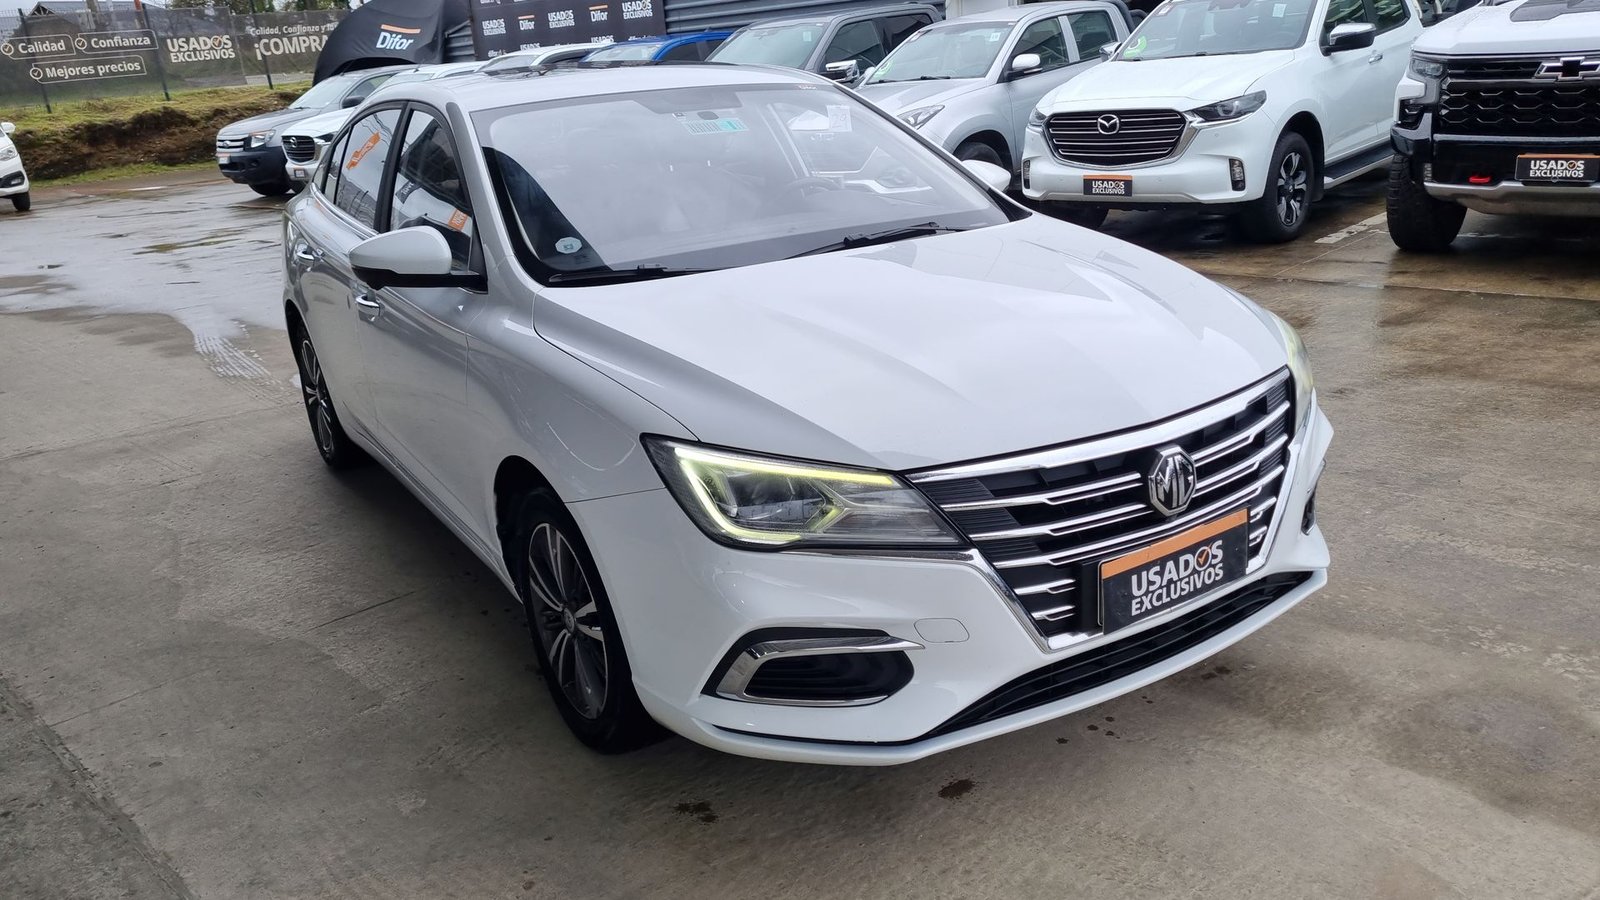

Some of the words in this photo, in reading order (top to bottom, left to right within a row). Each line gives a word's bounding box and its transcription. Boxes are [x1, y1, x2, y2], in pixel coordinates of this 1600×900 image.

[622, 0, 652, 12] USADOS
[548, 10, 574, 21] USADOS
[590, 11, 608, 22] Difor
[623, 9, 653, 20] EXCLUSIVOS
[283, 24, 319, 35] Confianza
[482, 19, 505, 29] USADOS
[519, 20, 535, 30] Difor
[91, 36, 151, 49] Confianza
[166, 35, 232, 52] USADOS
[376, 31, 414, 50] Difor
[18, 40, 65, 54] Calidad
[170, 49, 235, 63] EXCLUSIVOS
[45, 66, 94, 79] Mejores
[97, 61, 141, 76] precios
[1530, 160, 1585, 171] USADOS
[1529, 170, 1584, 178] EXCLUSIVOS
[1092, 180, 1125, 189] USADOS
[1155, 455, 1194, 509] MG
[1131, 540, 1224, 598] USADOS
[1131, 563, 1224, 617] EXCLUSIVOS
